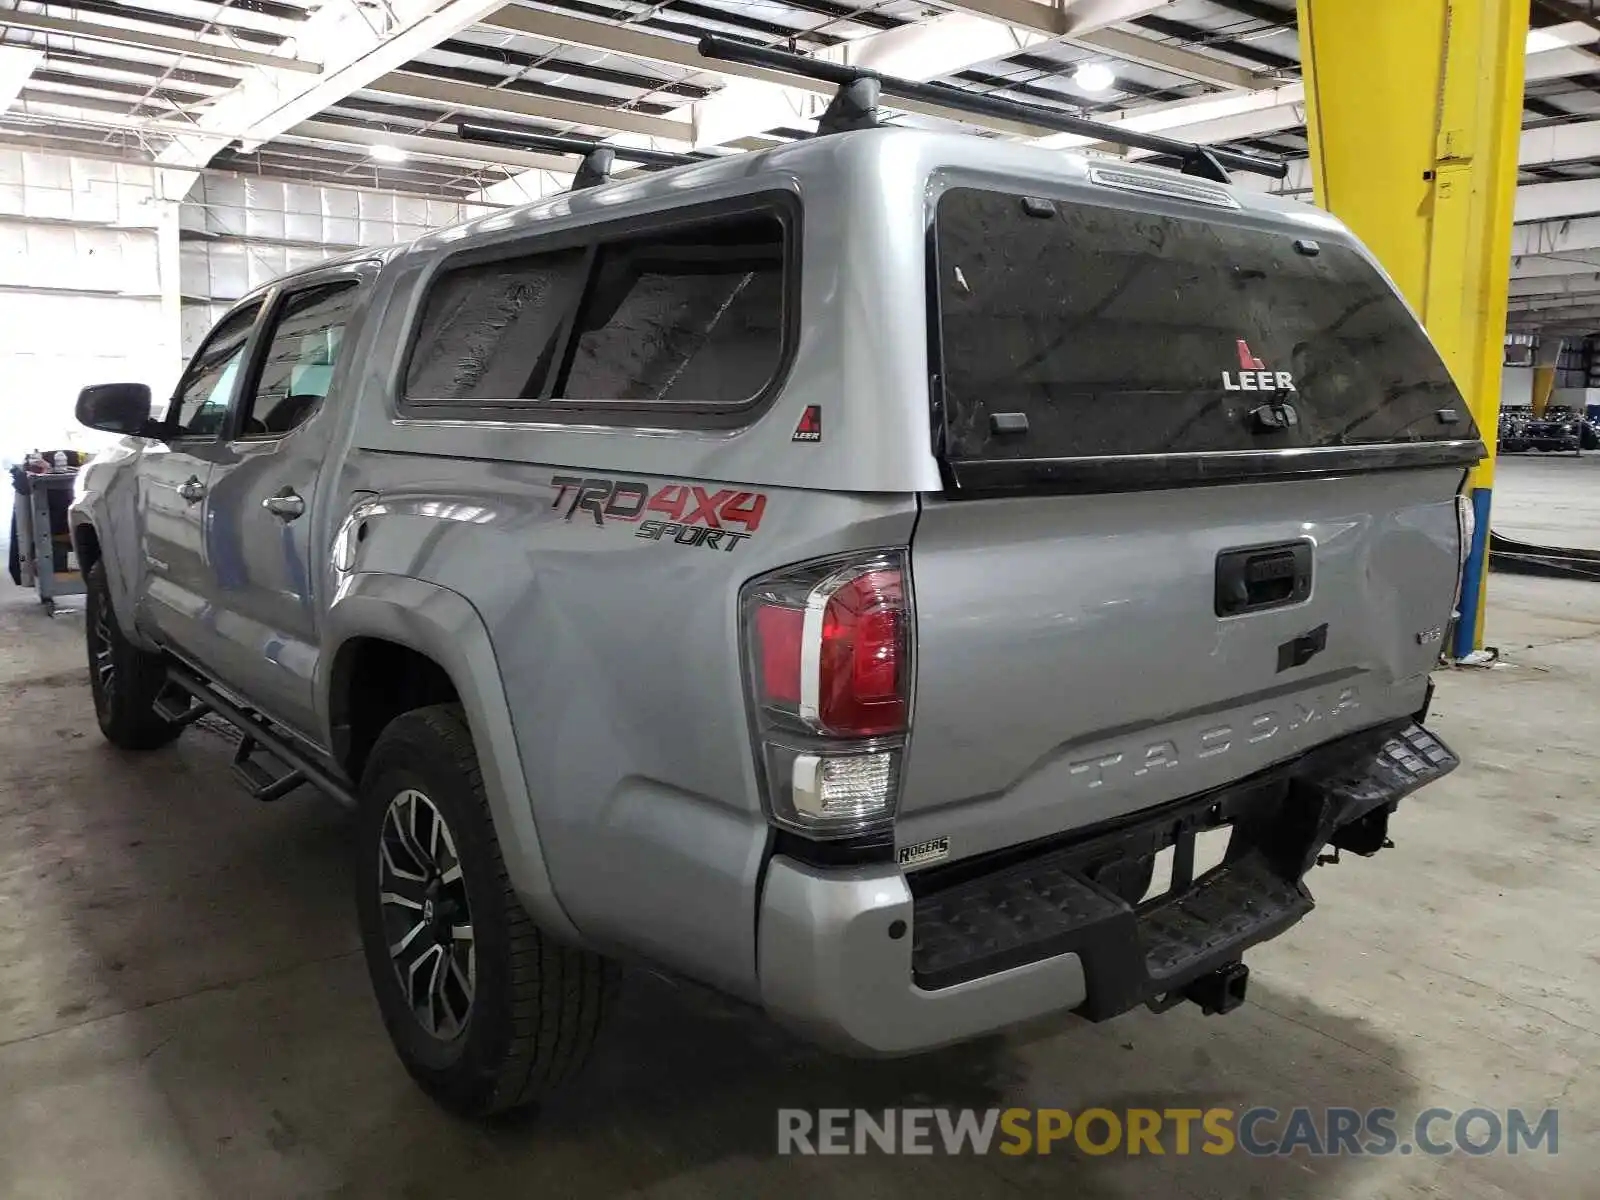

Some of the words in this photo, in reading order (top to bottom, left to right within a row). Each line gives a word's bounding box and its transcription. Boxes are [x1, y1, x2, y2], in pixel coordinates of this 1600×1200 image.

[1222, 371, 1296, 391] LEER
[634, 519, 751, 552] SPORT
[1069, 686, 1360, 788] TACOMA
[899, 838, 949, 863] ROGERS
